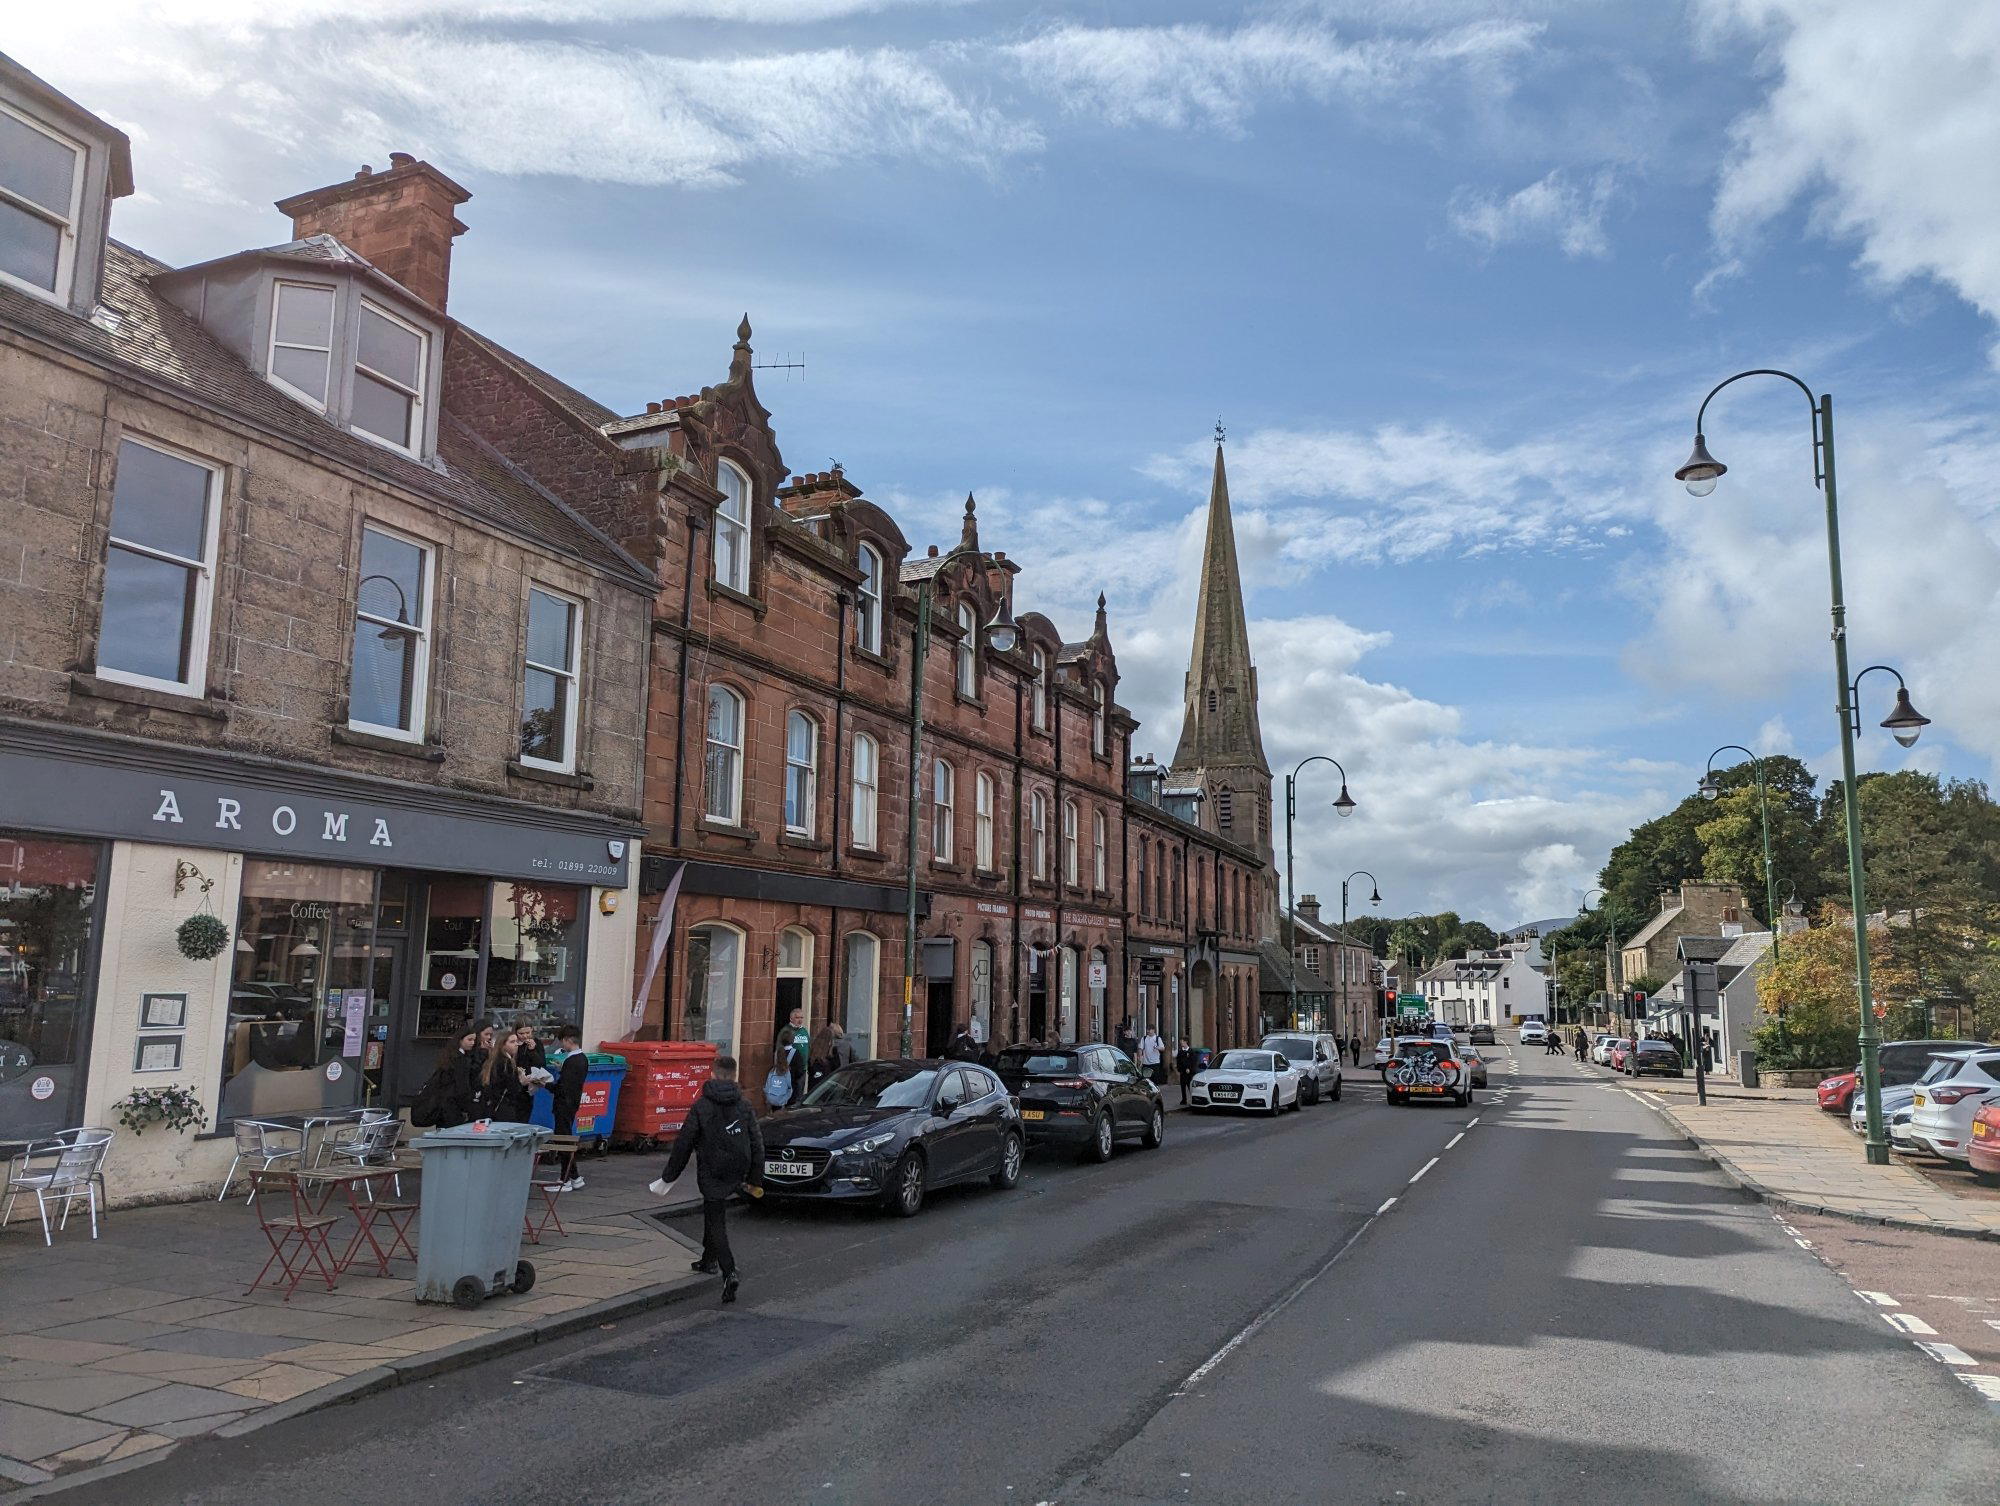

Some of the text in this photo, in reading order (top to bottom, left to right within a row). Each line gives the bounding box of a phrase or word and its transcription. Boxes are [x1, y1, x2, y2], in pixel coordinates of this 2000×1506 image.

[153, 790, 392, 846] AROMA
[532, 859, 617, 875] tel: 01899 220009
[290, 902, 331, 919] Coffee
[790, 1164, 807, 1175] CVE
